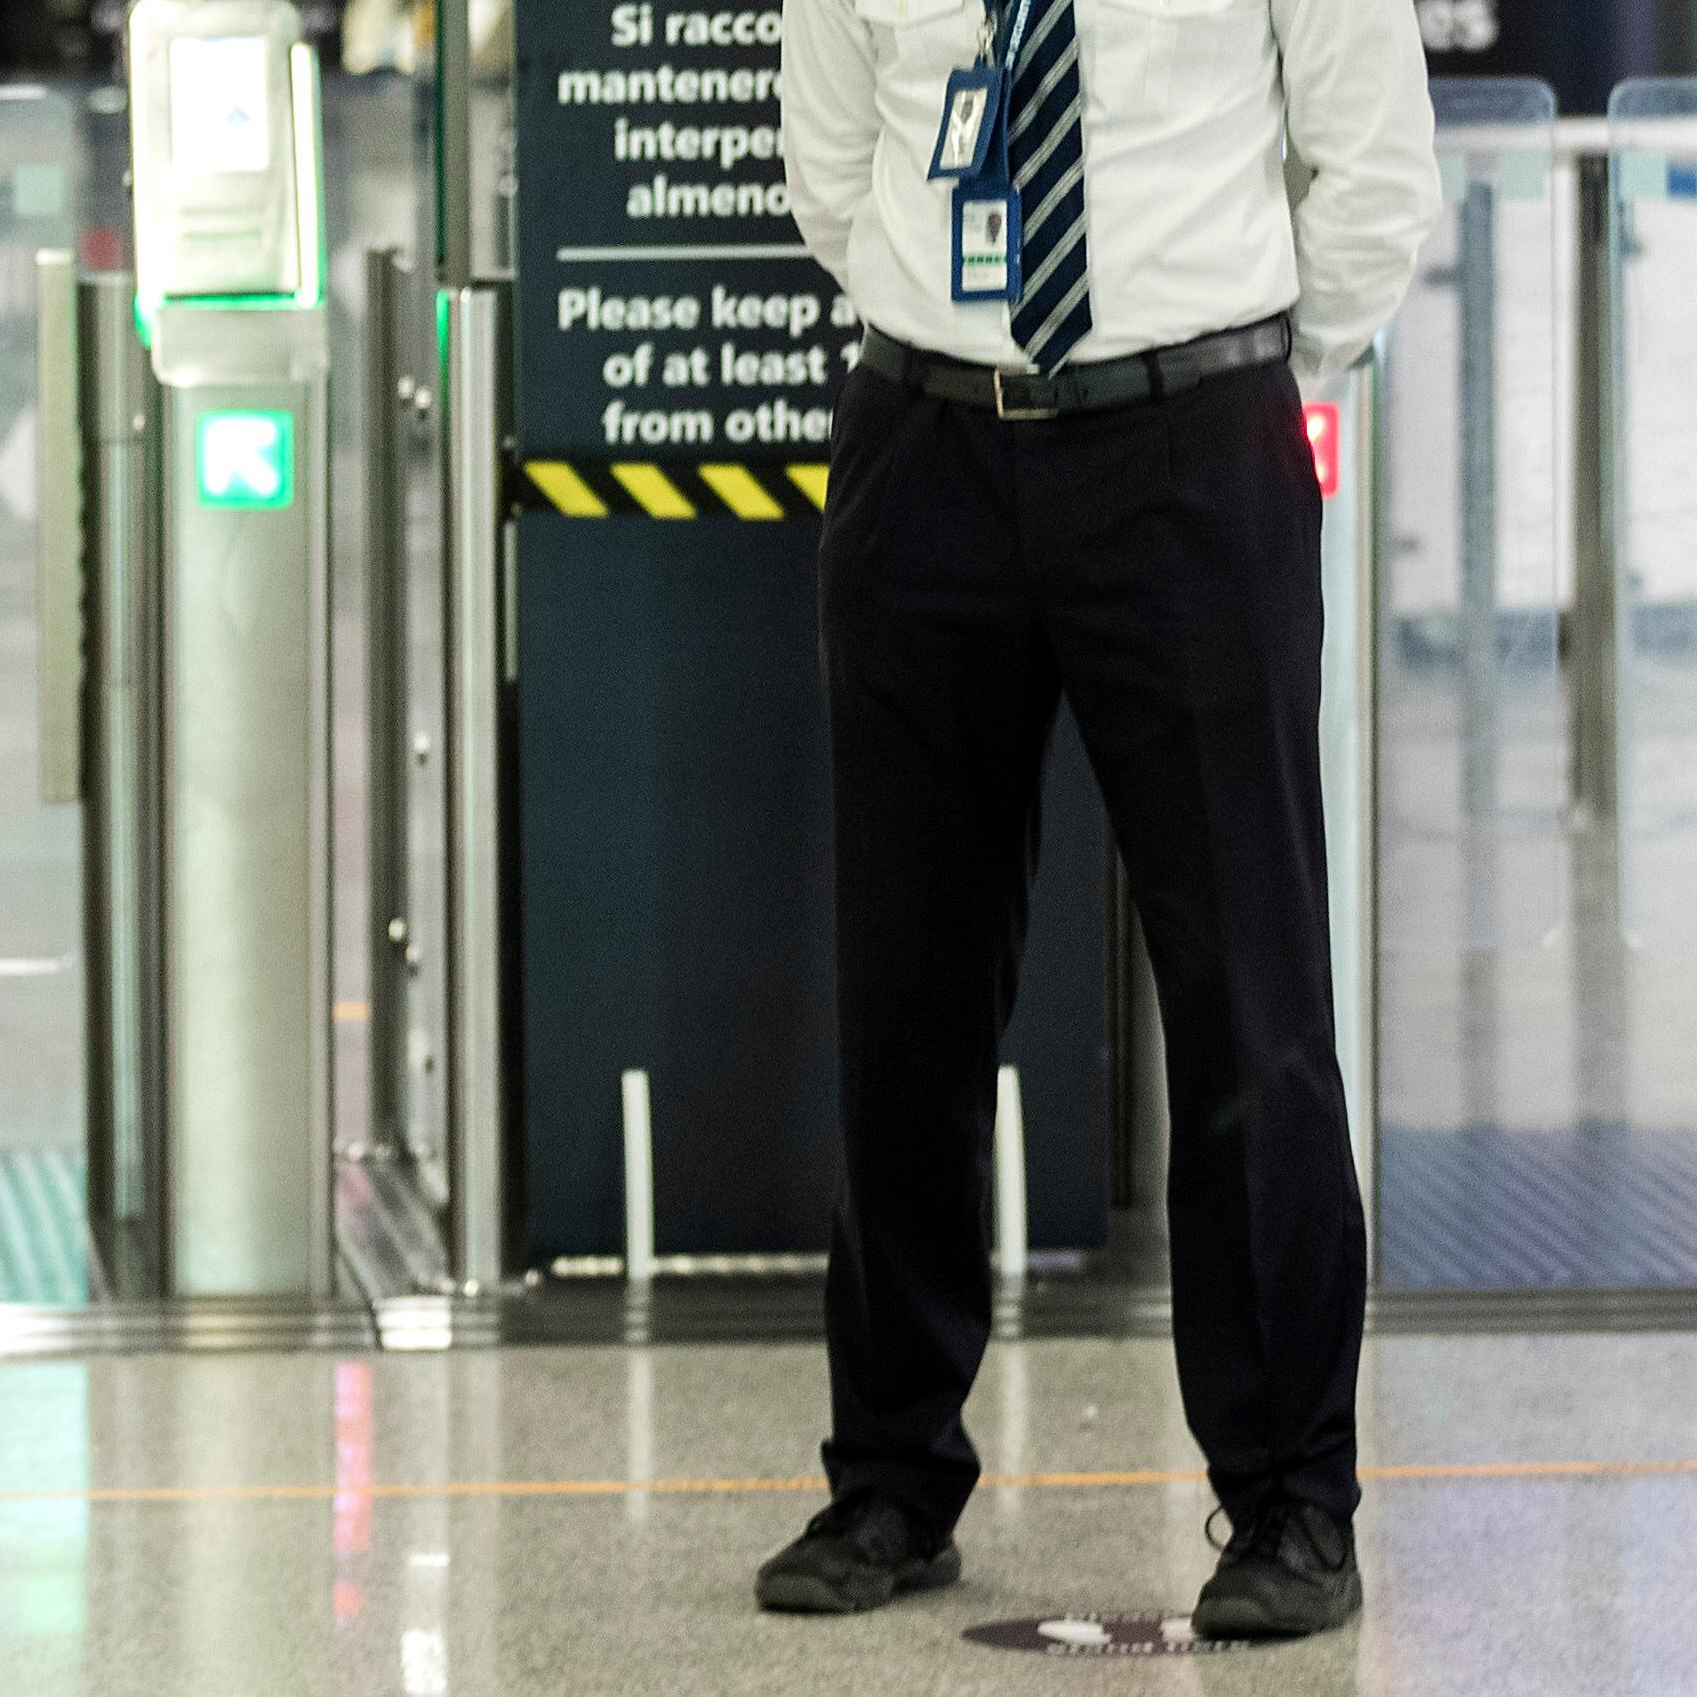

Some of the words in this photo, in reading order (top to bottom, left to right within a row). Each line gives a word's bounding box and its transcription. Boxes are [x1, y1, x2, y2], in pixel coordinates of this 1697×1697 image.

[612, 4, 652, 46] Si
[666, 8, 785, 49] racco
[615, 114, 786, 169] interpe
[627, 170, 793, 217] almeno
[559, 287, 699, 330] Please
[712, 285, 820, 337] keep
[830, 295, 857, 329] a
[603, 343, 652, 387] of
[663, 349, 708, 385] at
[721, 343, 826, 385] least
[603, 401, 713, 443] from
[725, 399, 833, 442] othe
